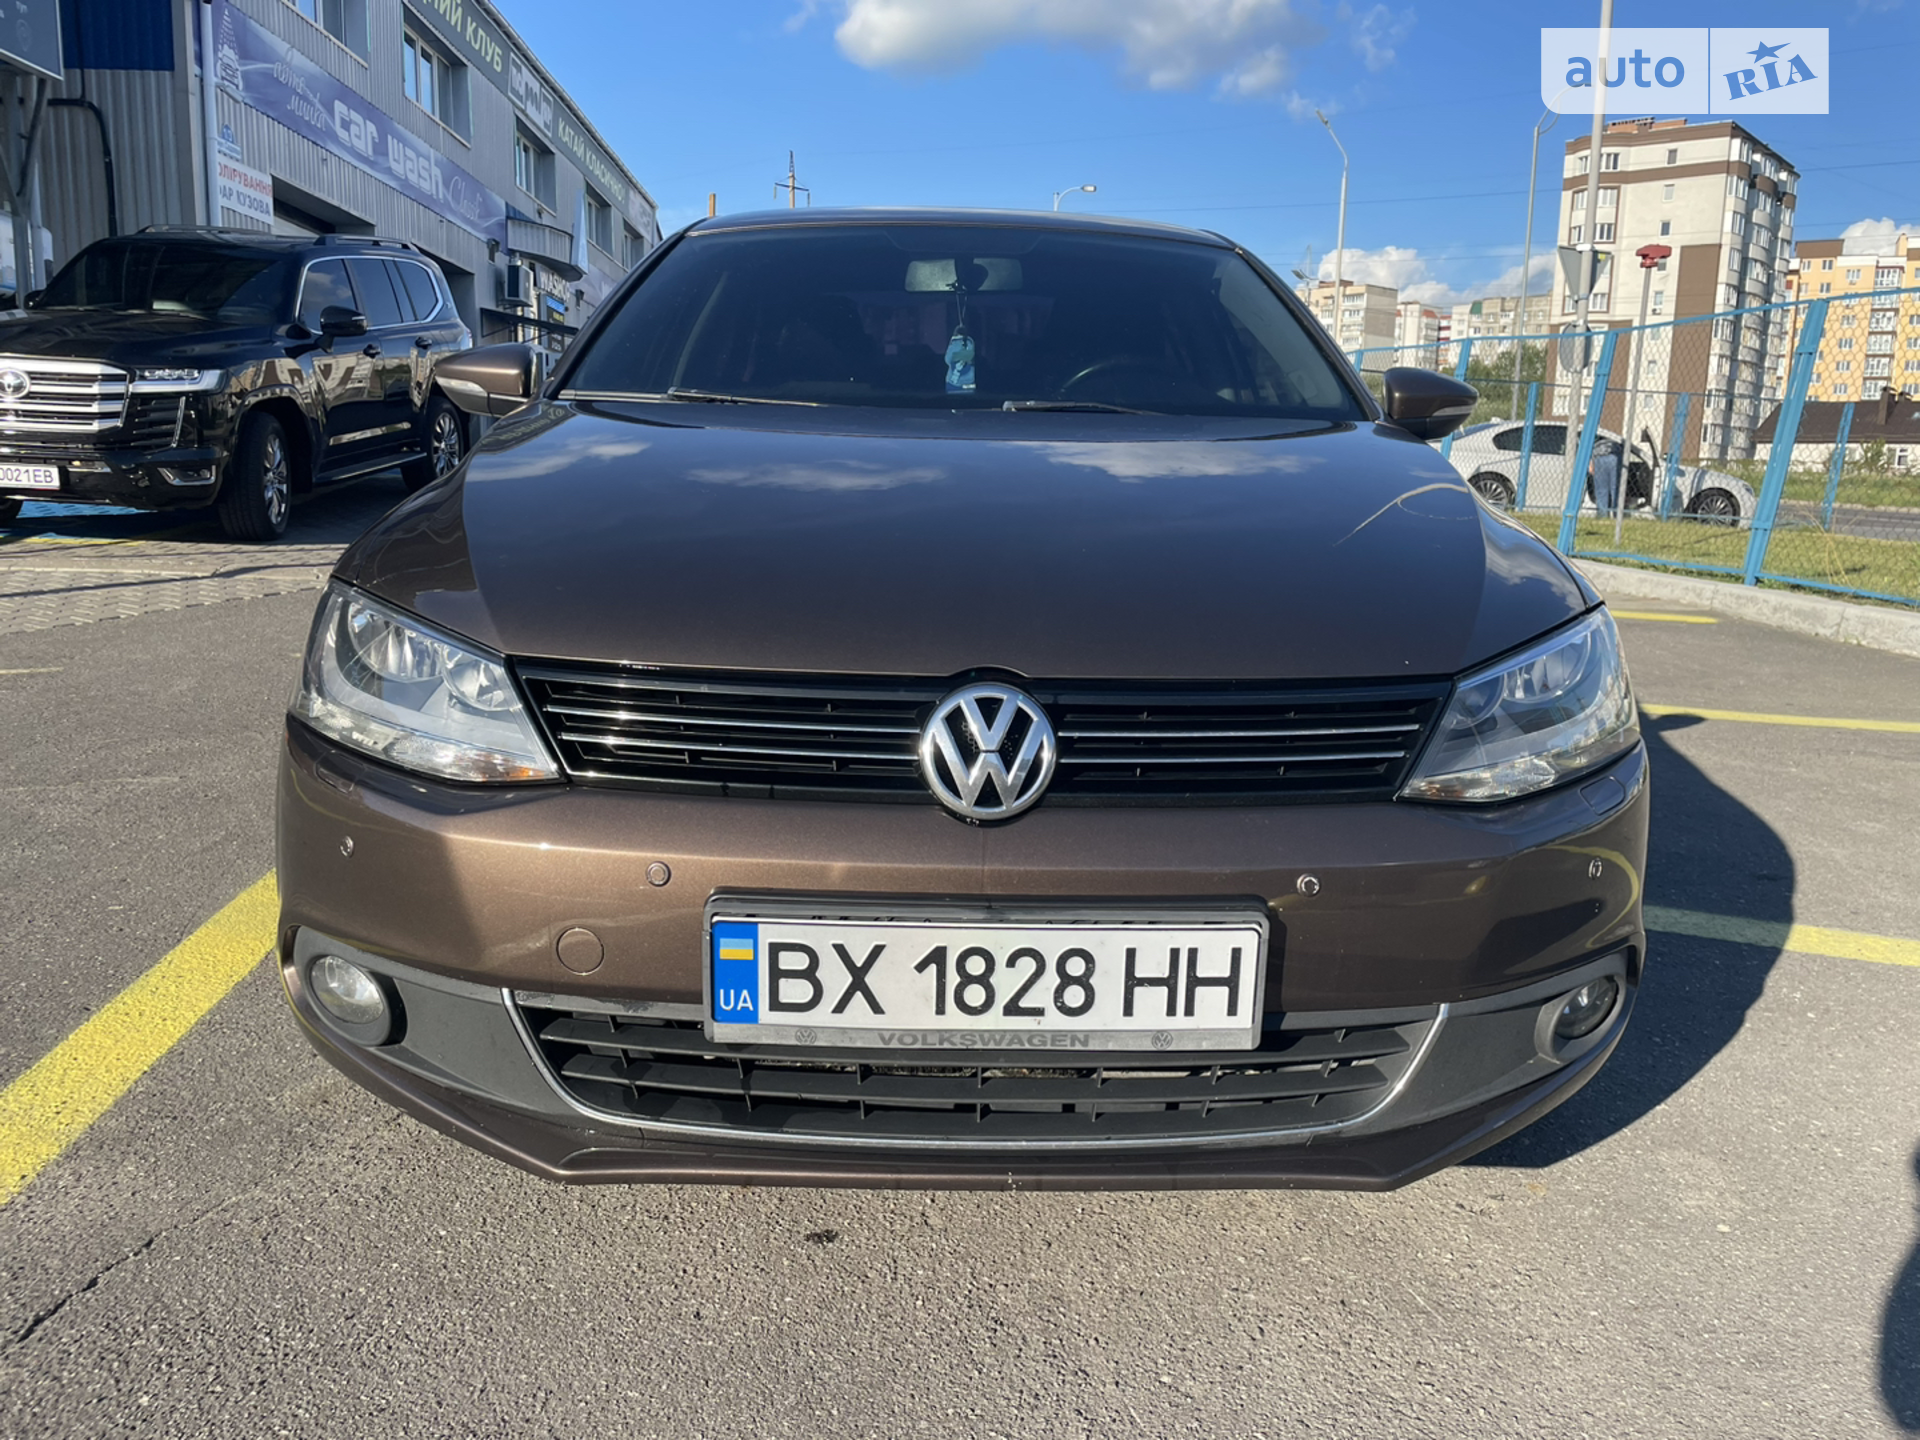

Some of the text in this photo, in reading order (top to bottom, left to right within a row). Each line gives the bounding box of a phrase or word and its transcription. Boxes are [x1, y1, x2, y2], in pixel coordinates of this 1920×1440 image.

[466, 15, 503, 73] КЛУБ
[236, 190, 271, 217] КУЗОВА
[768, 941, 1242, 1018] BX 1828 HH
[719, 988, 754, 1012] UA
[878, 1031, 1089, 1049] VOLKSWAGEN
